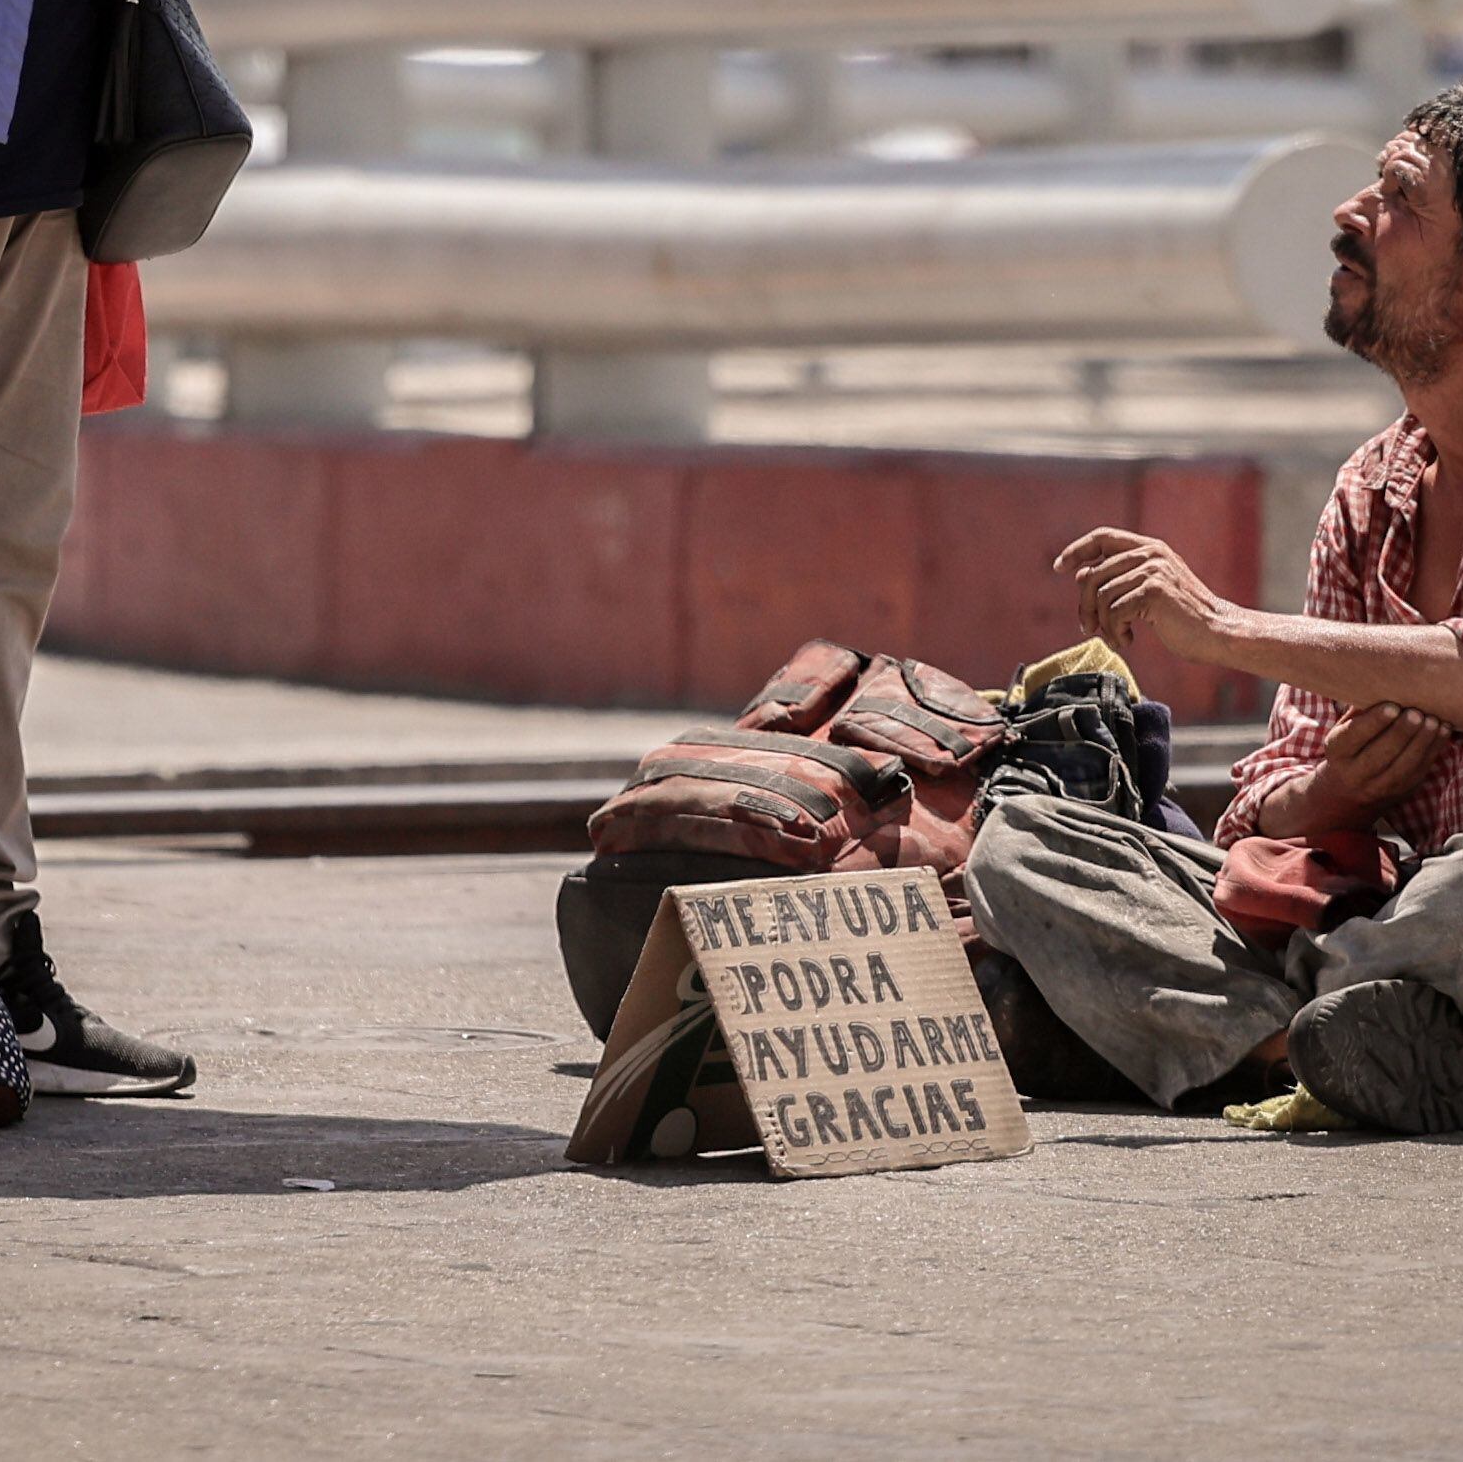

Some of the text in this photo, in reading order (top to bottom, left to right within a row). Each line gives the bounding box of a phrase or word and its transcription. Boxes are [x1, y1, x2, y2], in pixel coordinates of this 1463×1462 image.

[688, 883, 940, 950] ME AYUDA
[732, 952, 904, 1014] PODRA
[741, 1014, 1000, 1083] AYUDARME
[776, 1079, 987, 1147] GRACIAS
